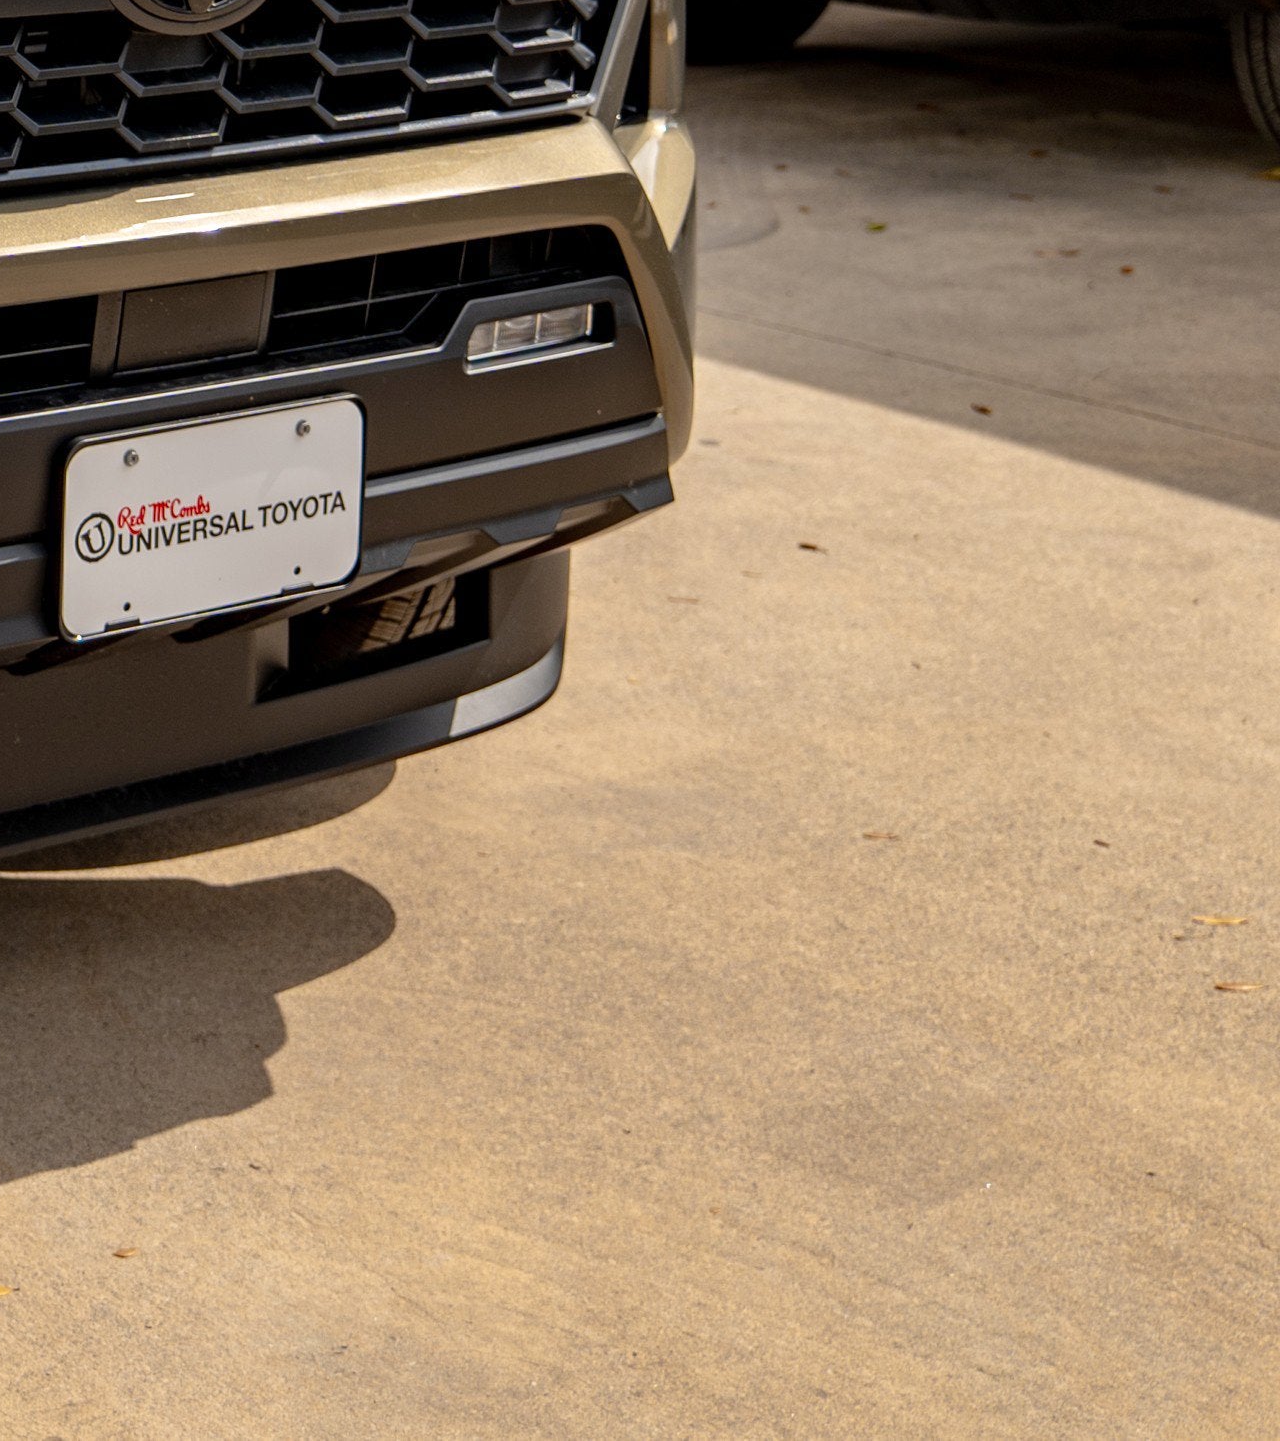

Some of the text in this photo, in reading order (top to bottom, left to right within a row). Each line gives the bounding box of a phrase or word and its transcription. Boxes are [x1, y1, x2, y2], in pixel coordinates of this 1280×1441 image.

[117, 506, 145, 535] Red
[118, 490, 346, 556] UNIVERSAL TOYOTA
